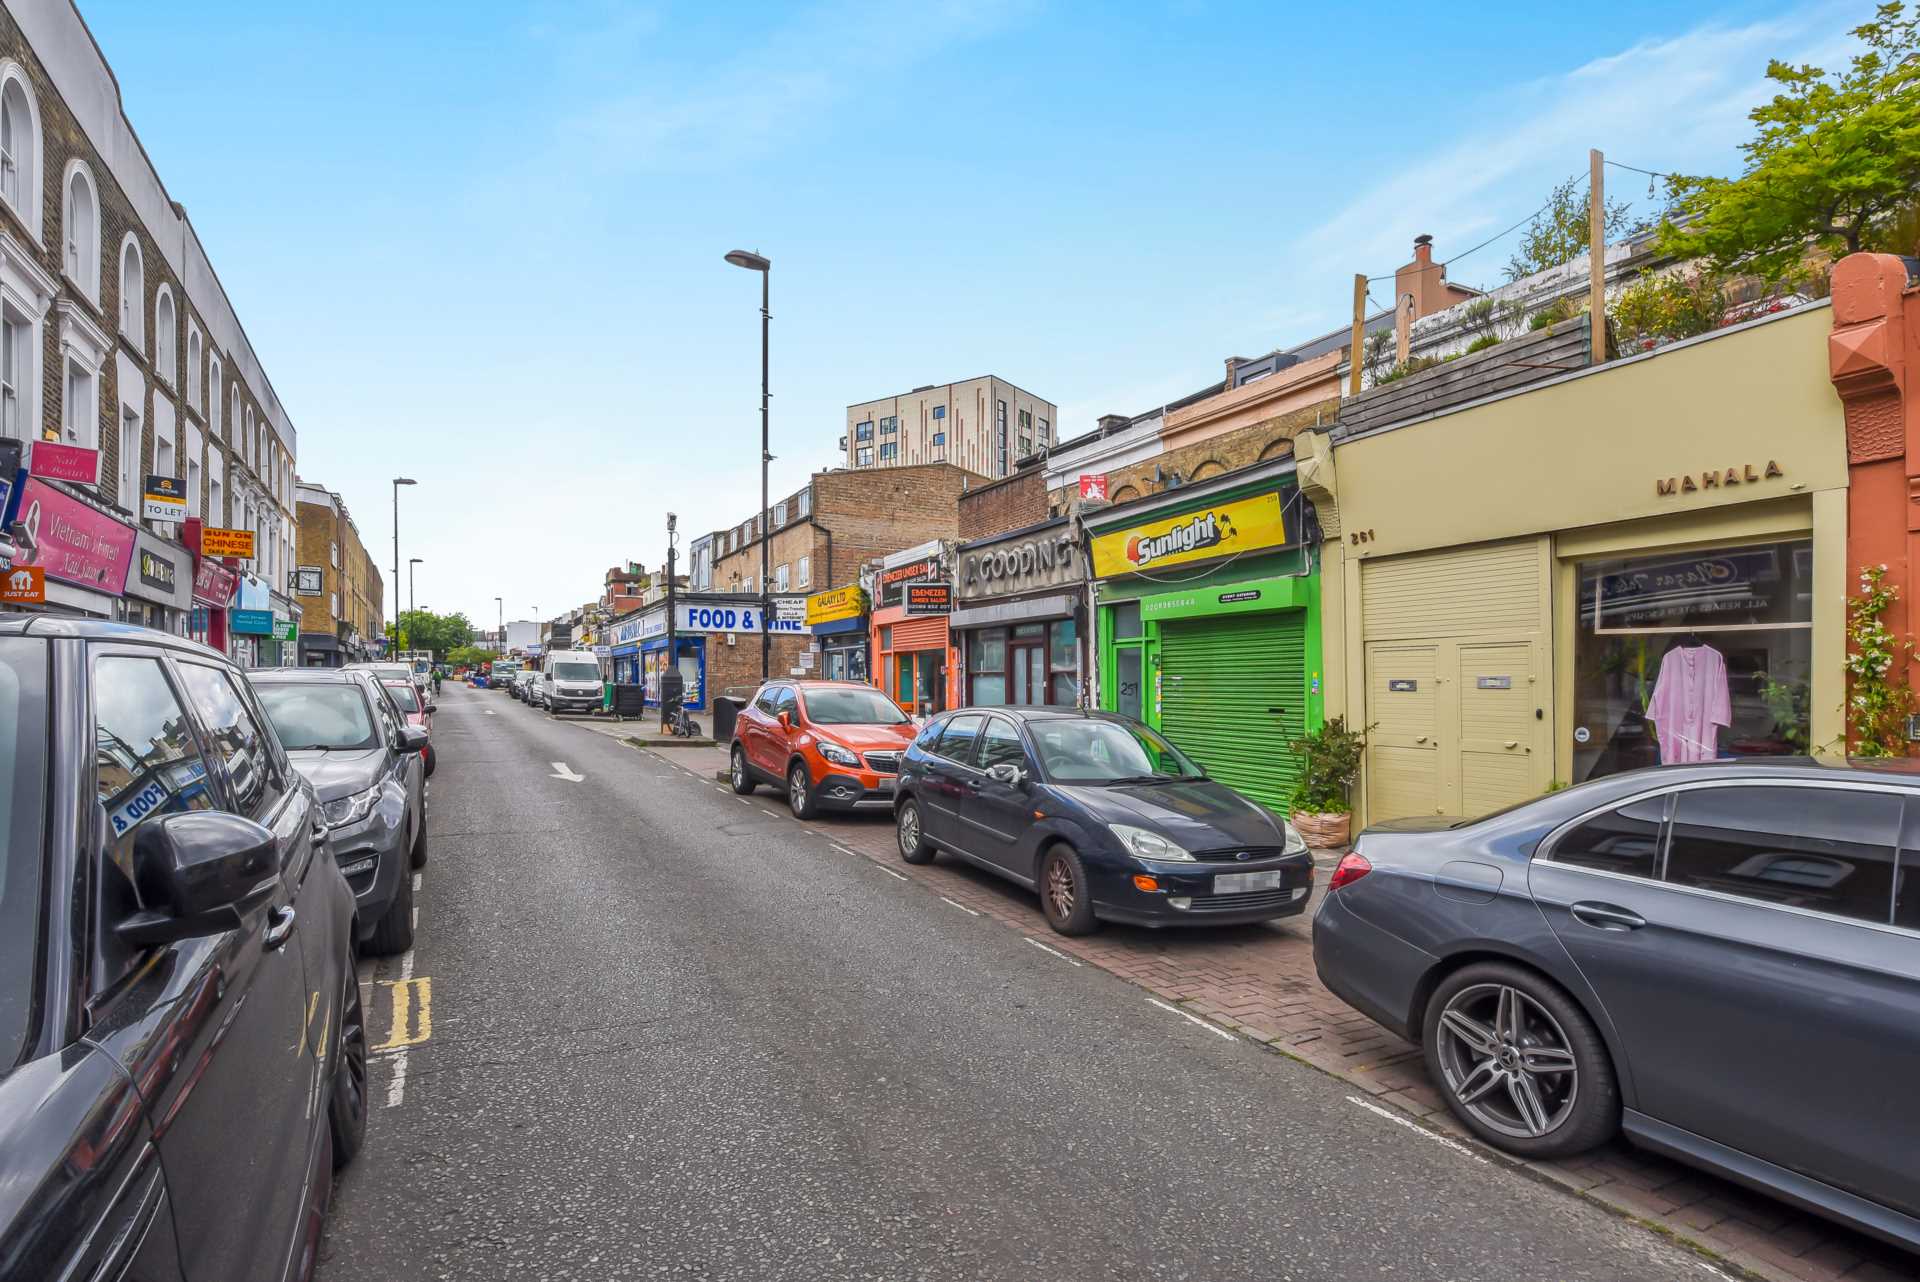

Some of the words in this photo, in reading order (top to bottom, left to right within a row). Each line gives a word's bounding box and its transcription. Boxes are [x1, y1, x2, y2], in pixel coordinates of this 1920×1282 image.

[1656, 460, 1783, 496] MAHALA
[148, 504, 162, 514] TO
[165, 507, 183, 517] LET
[204, 529, 230, 538] SUN
[235, 531, 252, 539] ON
[1137, 512, 1217, 567] Sunlight
[203, 538, 252, 551] CHINESE
[208, 548, 225, 556] TAKE
[980, 534, 1074, 580] GOODING
[817, 593, 836, 608] GALAXY
[836, 591, 846, 603] LTD
[911, 588, 947, 597] EBENEZER
[689, 608, 736, 629] FOOD
[742, 610, 754, 630] &
